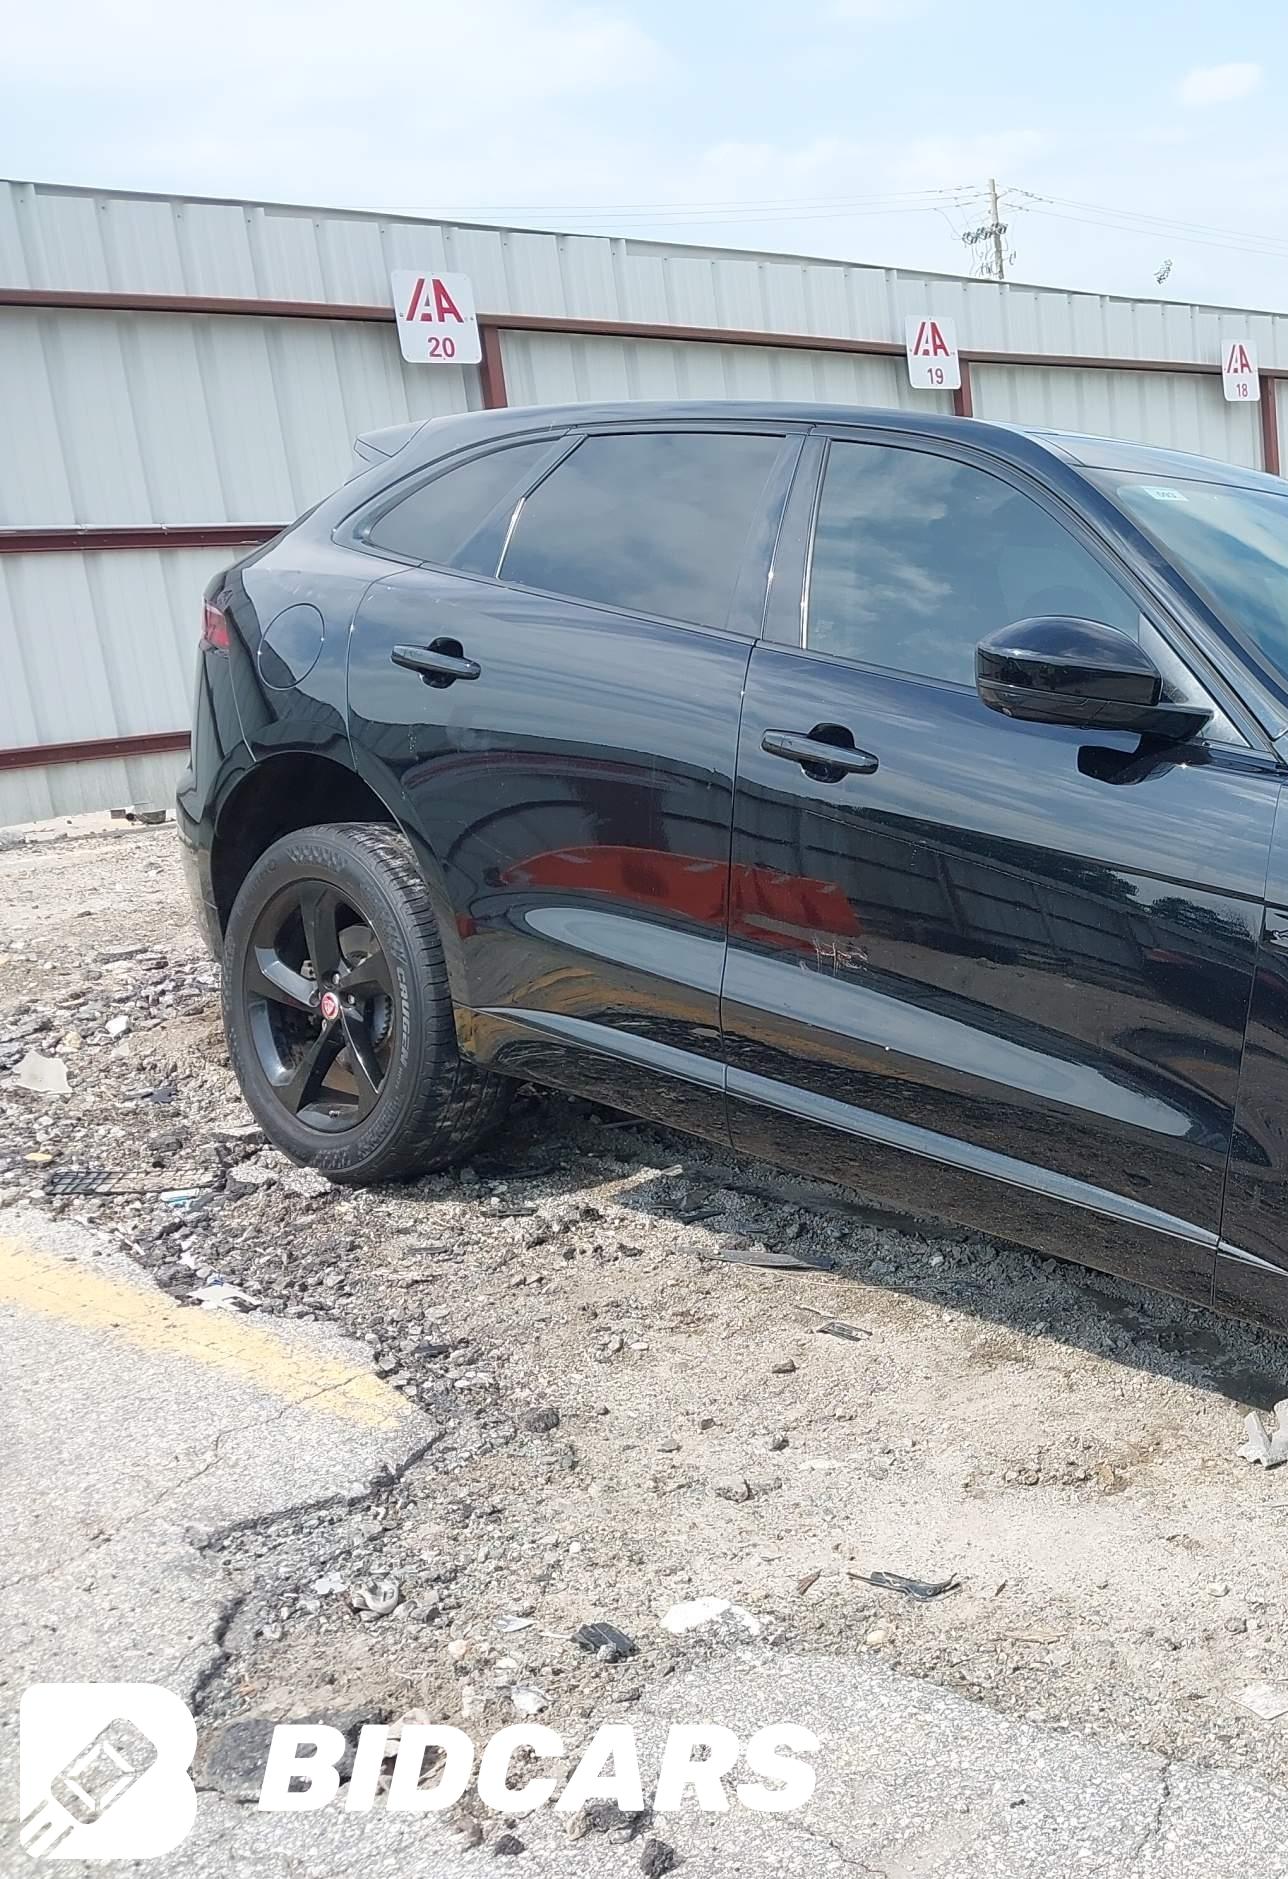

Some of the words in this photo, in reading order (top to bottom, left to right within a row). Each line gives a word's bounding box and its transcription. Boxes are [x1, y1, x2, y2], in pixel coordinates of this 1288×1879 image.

[427, 336, 455, 357] 20
[927, 367, 944, 384] 19
[1236, 383, 1248, 397] 18
